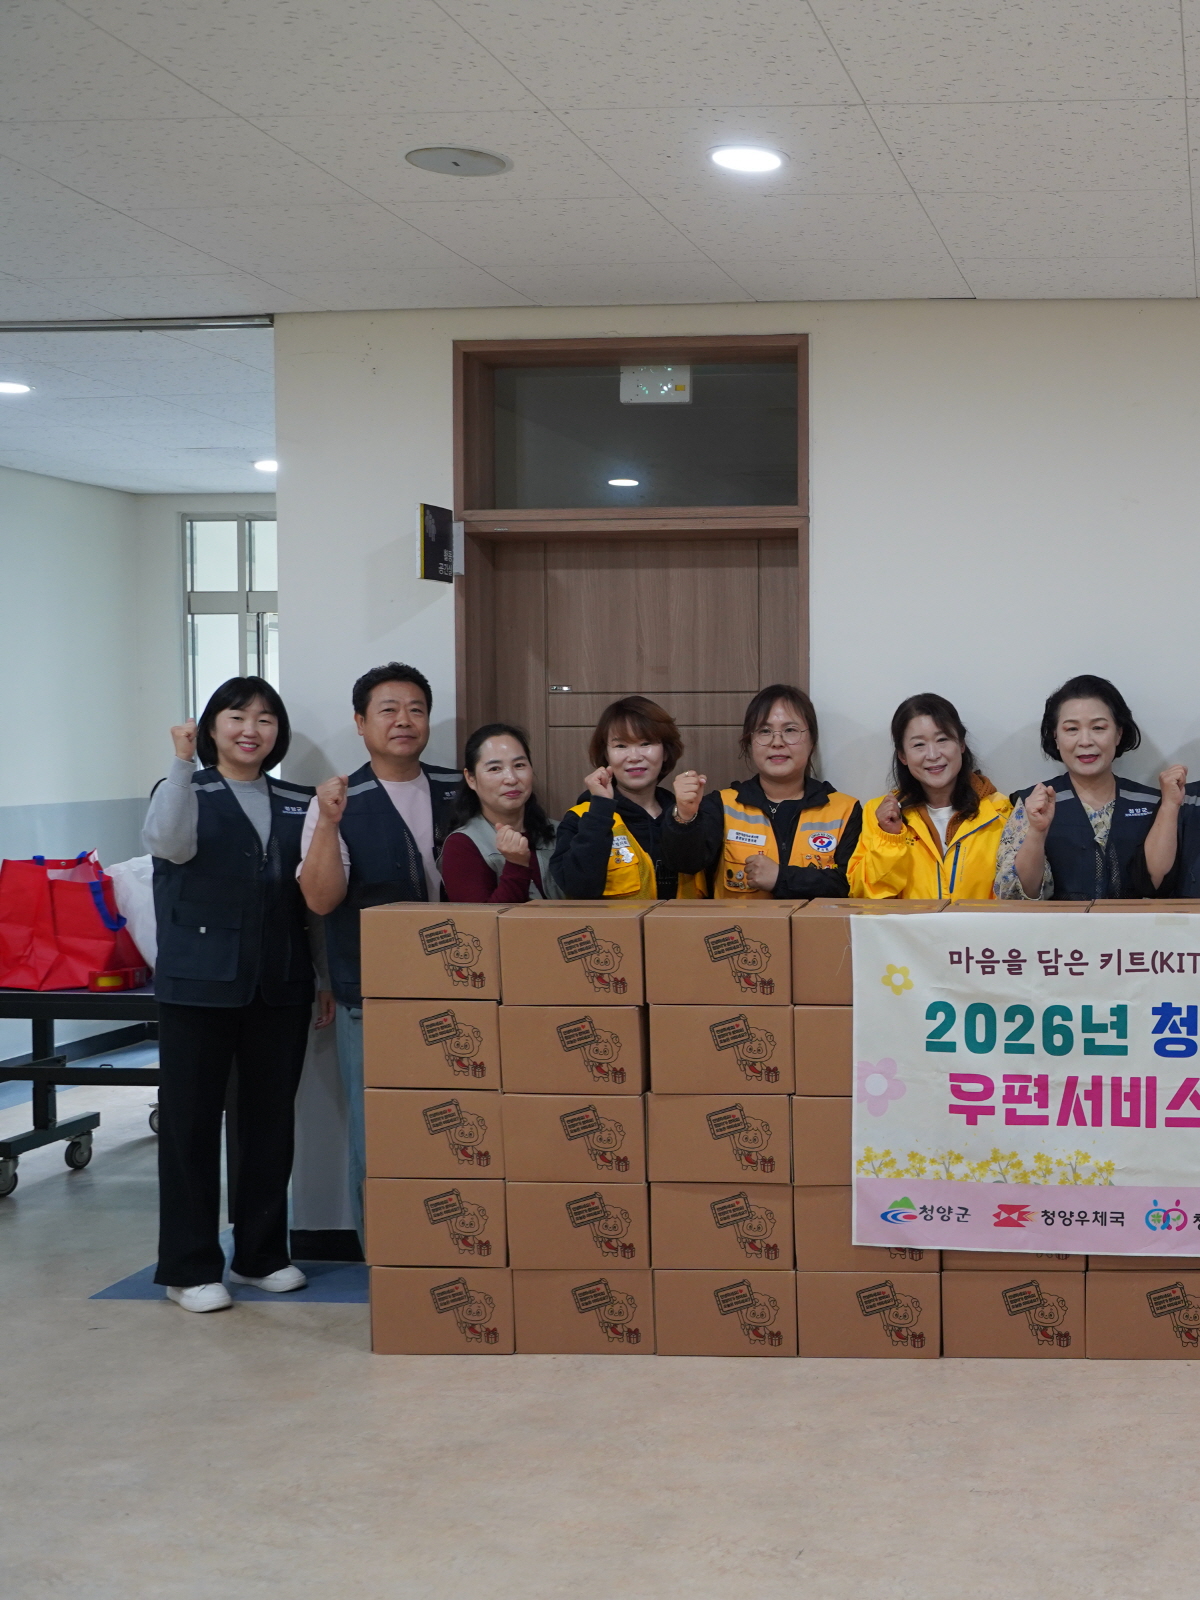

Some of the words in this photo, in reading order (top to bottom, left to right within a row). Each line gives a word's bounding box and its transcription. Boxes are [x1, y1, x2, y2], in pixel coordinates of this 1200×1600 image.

[949, 947, 1027, 976] 마음을
[1037, 948, 1089, 976] 담은
[926, 1001, 1128, 1056] 2026년
[919, 1204, 971, 1223] 청양군
[1041, 1209, 1125, 1227] 청양우체국
